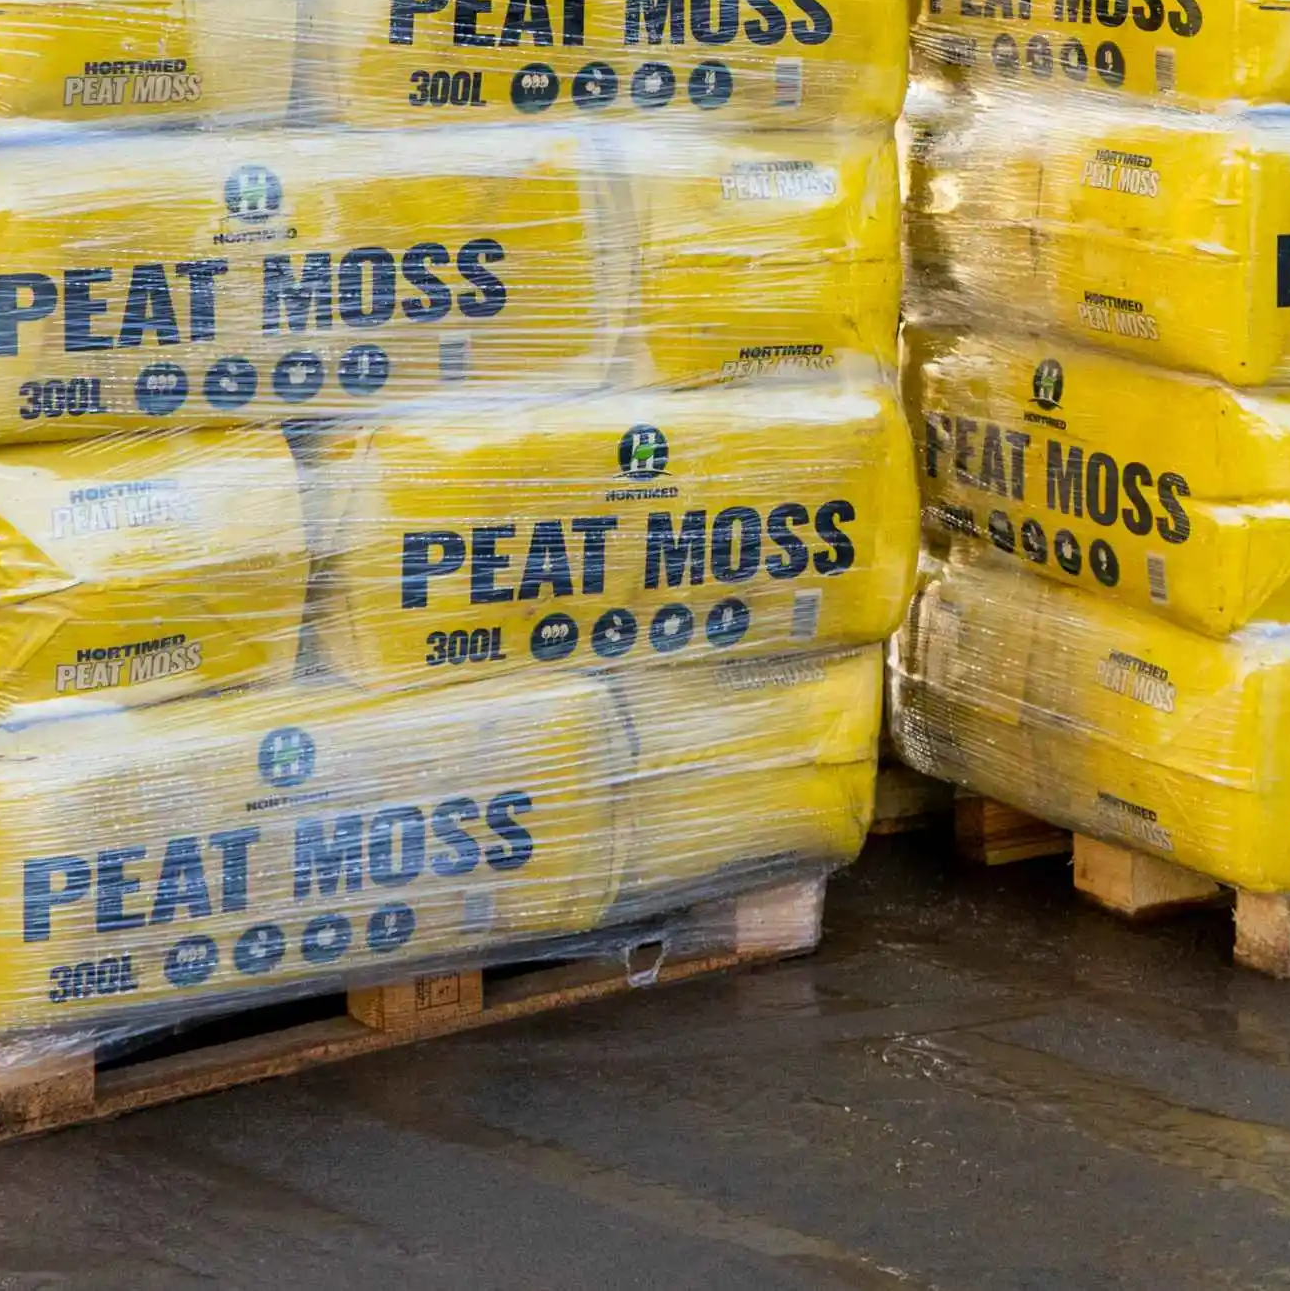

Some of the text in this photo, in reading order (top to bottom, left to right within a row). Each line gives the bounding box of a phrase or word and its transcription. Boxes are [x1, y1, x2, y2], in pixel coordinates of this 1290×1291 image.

[85, 59, 186, 76] HORTIMED
[65, 72, 202, 107] PEAT MOSS
[409, 70, 486, 107] 300L
[1096, 149, 1152, 168] HORTIMED
[721, 172, 771, 200] PEAT
[1080, 160, 1160, 198] PEAT MOSS
[262, 237, 507, 335] MOSS
[1084, 290, 1143, 313] HORTIMED
[1077, 301, 1158, 341] PEAT MOSS
[18, 377, 106, 420] 300L
[605, 486, 679, 503] HORTIMED
[922, 410, 1191, 544] PEAT MOSS
[50, 498, 120, 540] PEAT
[402, 499, 857, 610] PEAT MOSS
[77, 633, 186, 663] HORTIMED
[426, 627, 507, 666] 300L
[1110, 648, 1169, 683] HORTIMED
[56, 643, 202, 692] PEAT MOSS
[23, 790, 533, 944] PEAT MOSS
[49, 953, 138, 1003] 300L
